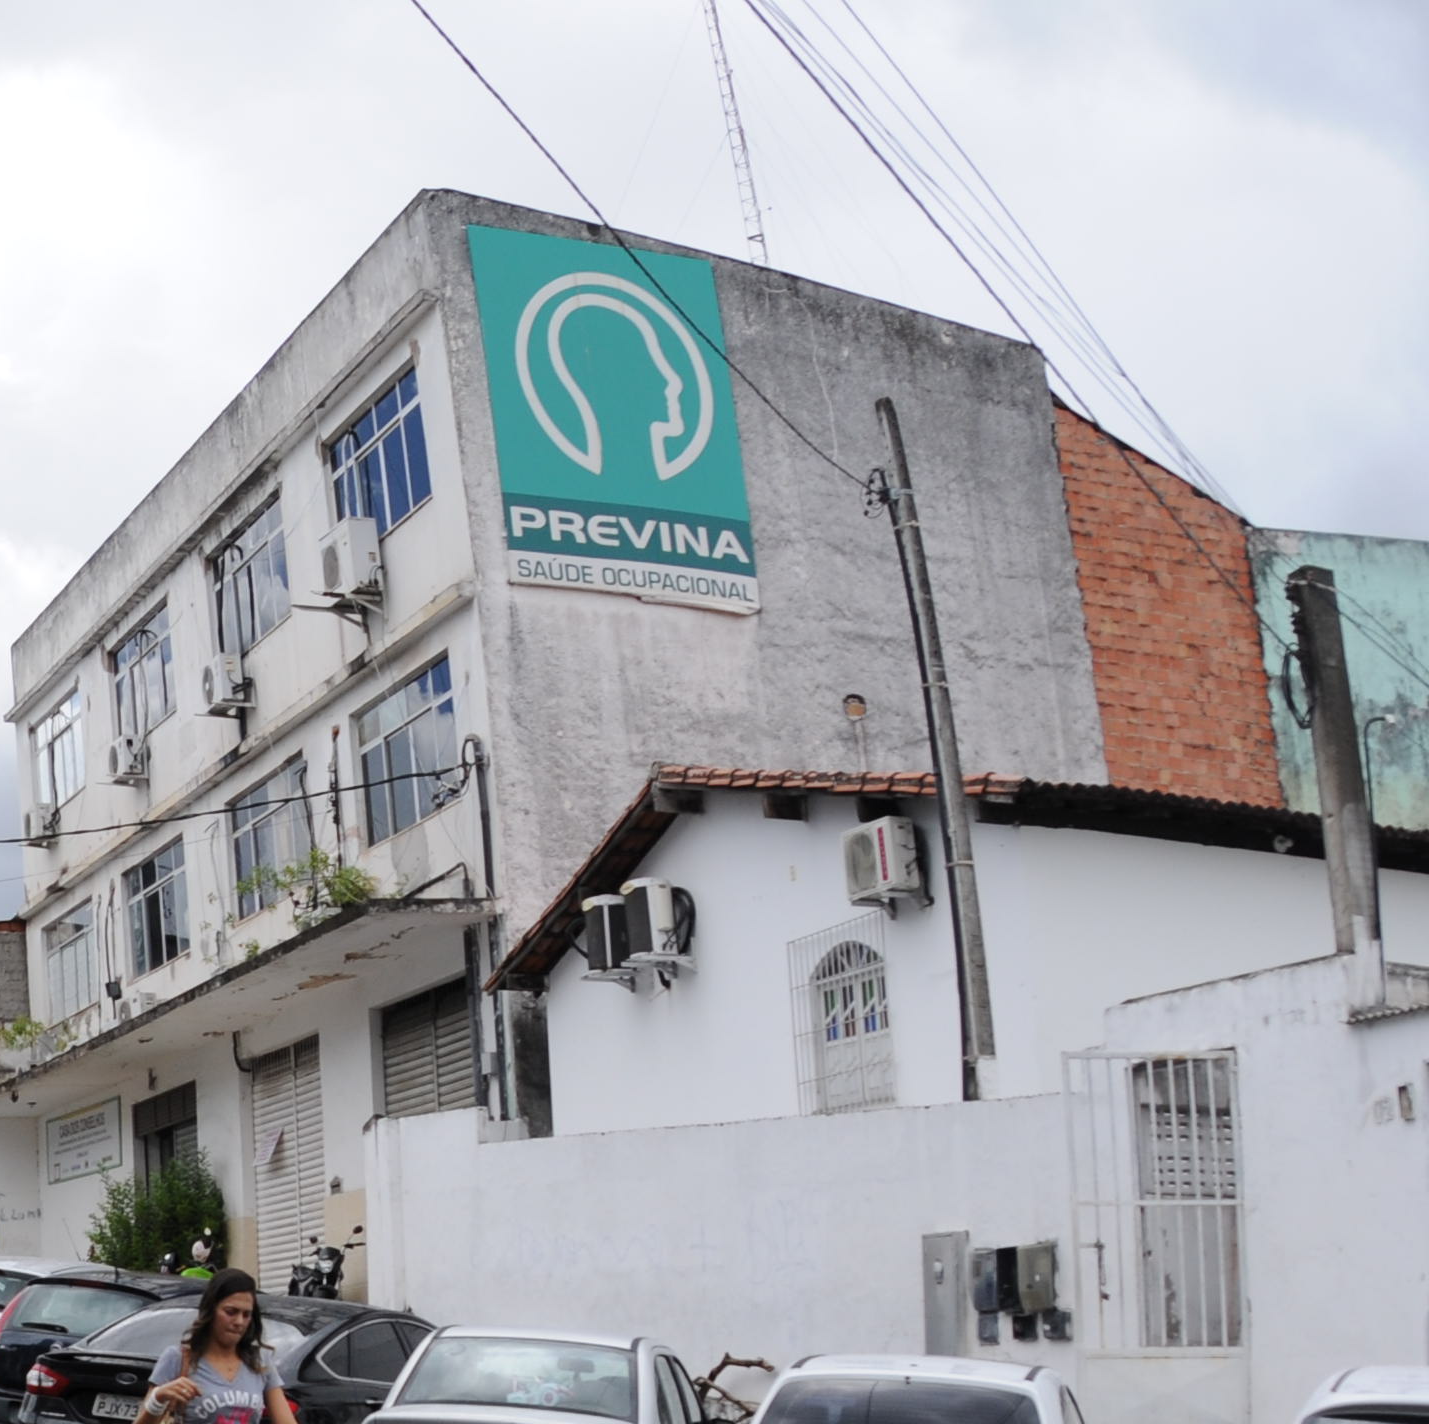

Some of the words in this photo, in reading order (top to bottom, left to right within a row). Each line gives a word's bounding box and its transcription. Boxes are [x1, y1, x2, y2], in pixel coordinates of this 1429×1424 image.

[509, 505, 749, 563] PREVINA
[517, 557, 594, 584] SAÚDE
[602, 566, 755, 602] OCUPACIONAL
